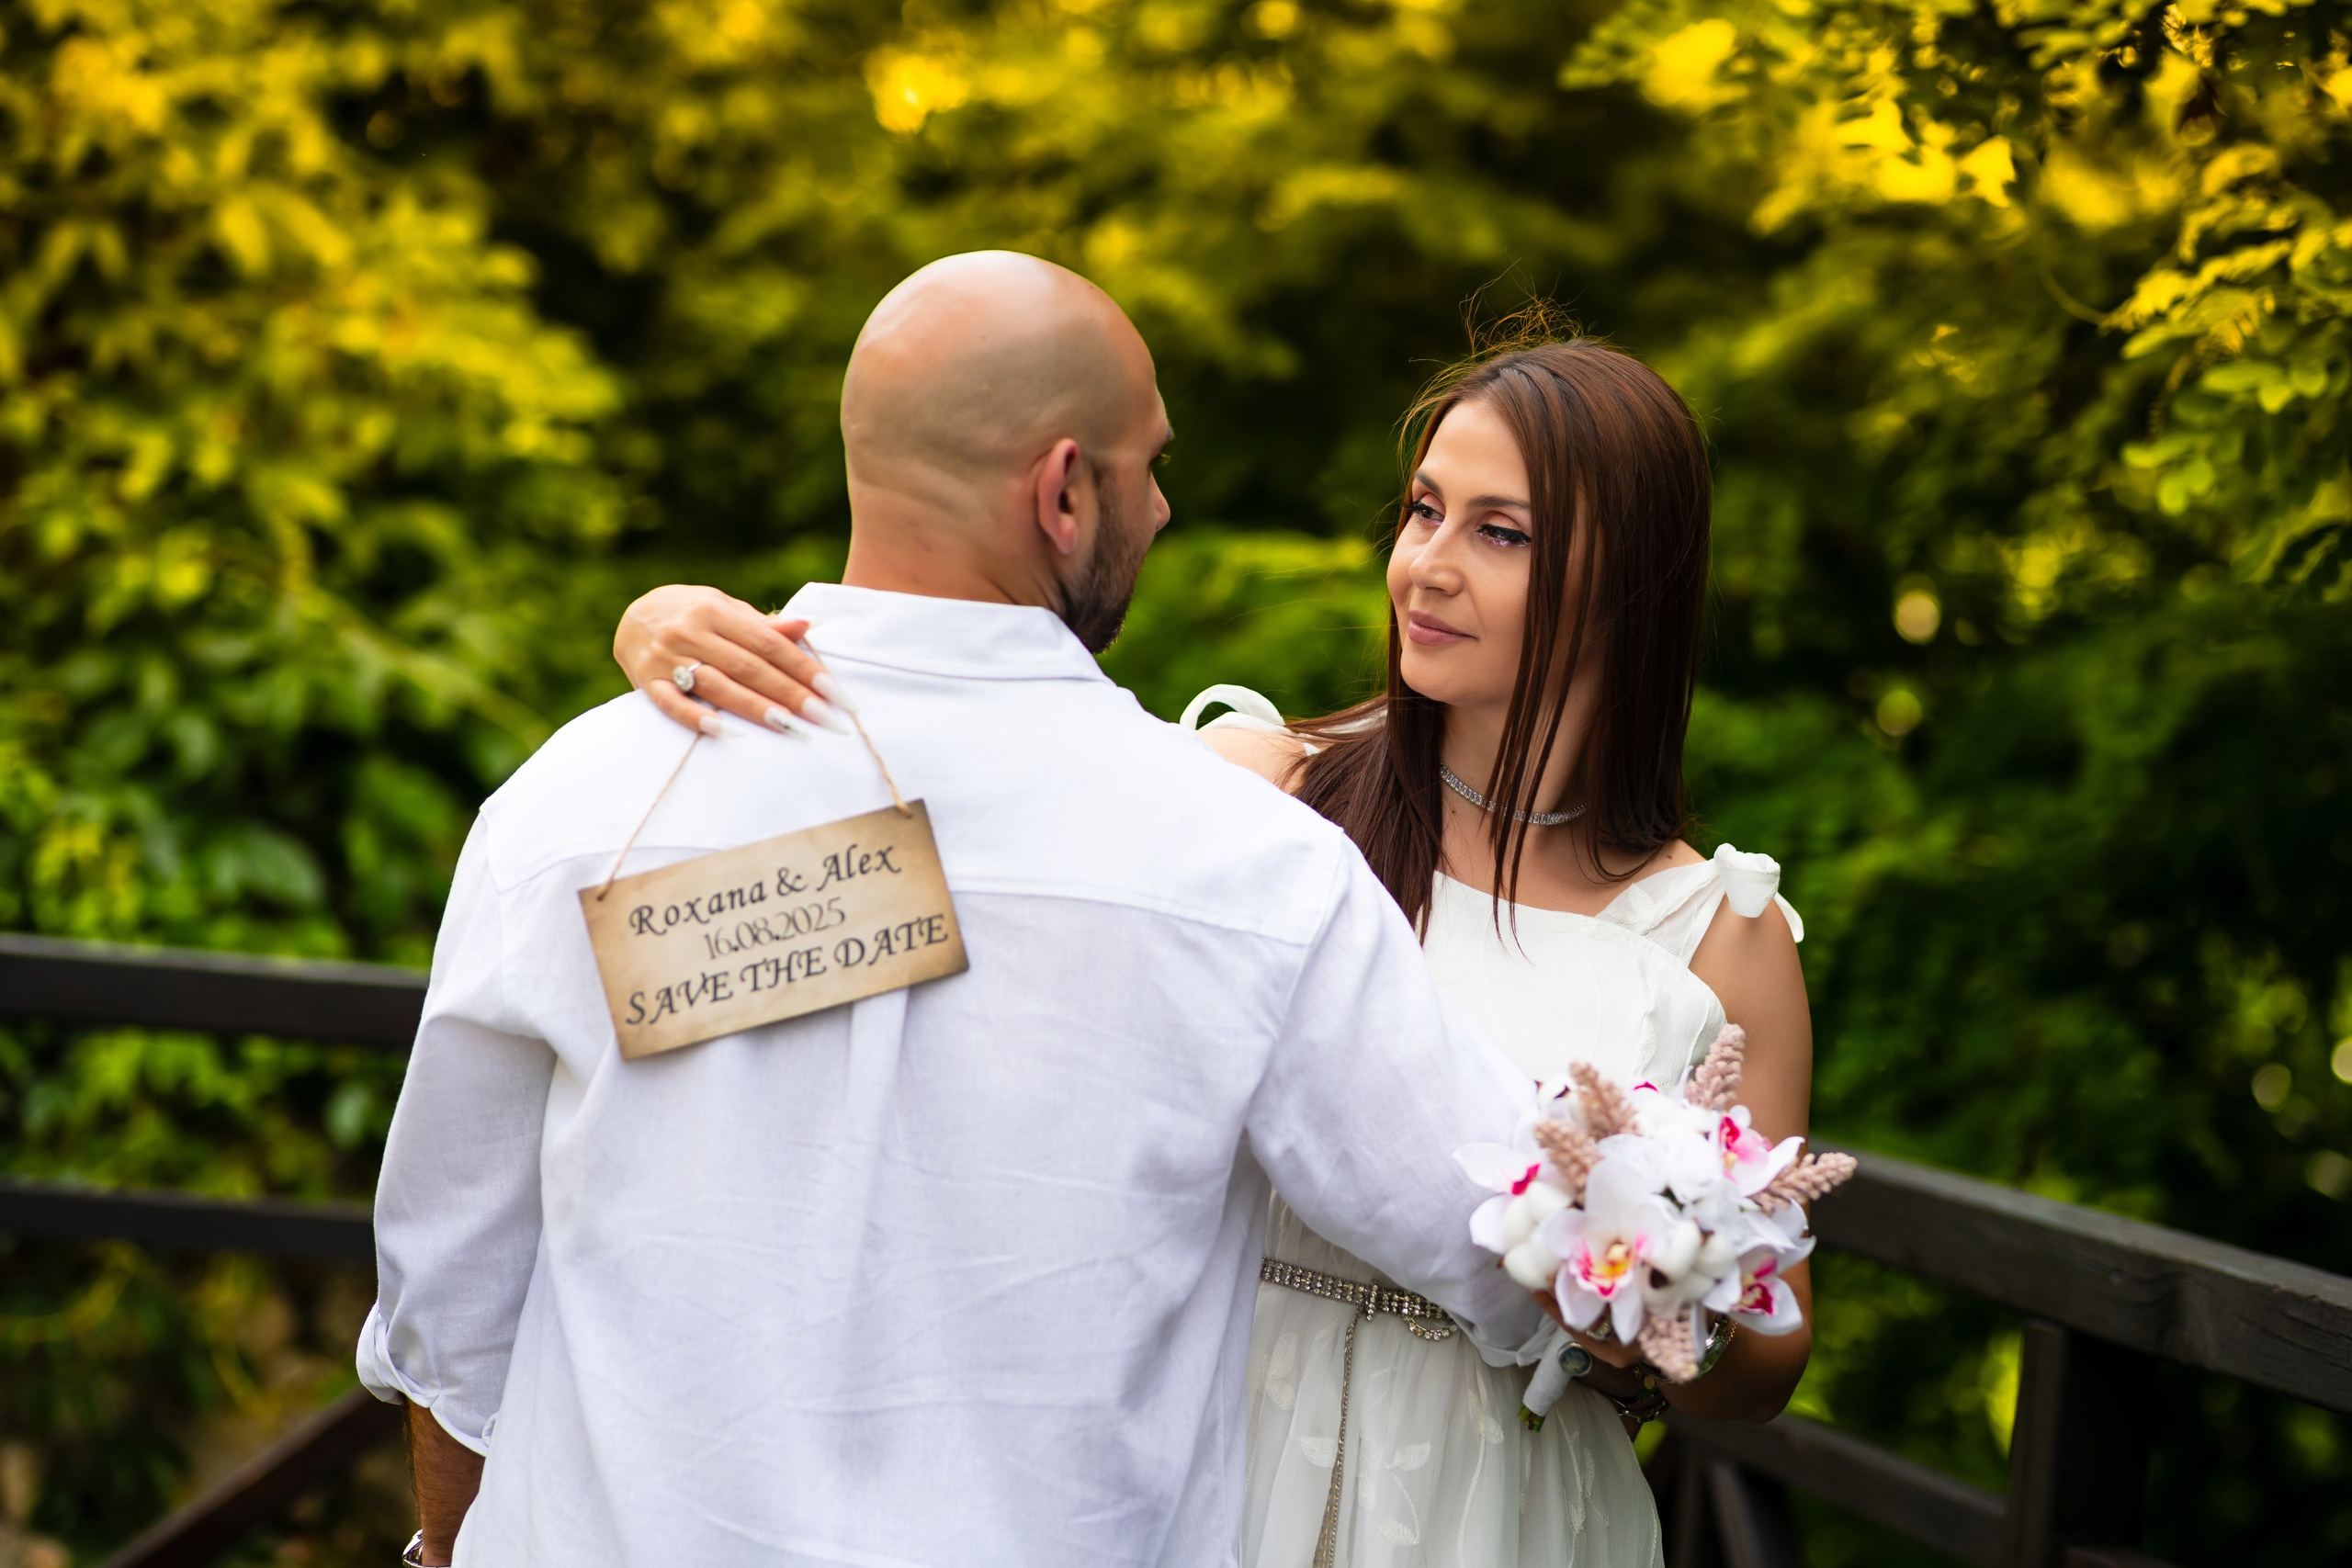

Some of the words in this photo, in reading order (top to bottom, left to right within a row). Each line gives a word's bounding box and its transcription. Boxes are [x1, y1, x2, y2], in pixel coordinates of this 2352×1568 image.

[628, 877, 768, 936] Roxana
[776, 866, 808, 897] &
[816, 843, 902, 891] Alex
[703, 897, 846, 959] 16.08.2025
[625, 971, 734, 1025] SAVE
[740, 946, 828, 994] THE
[834, 913, 949, 968] DATE
